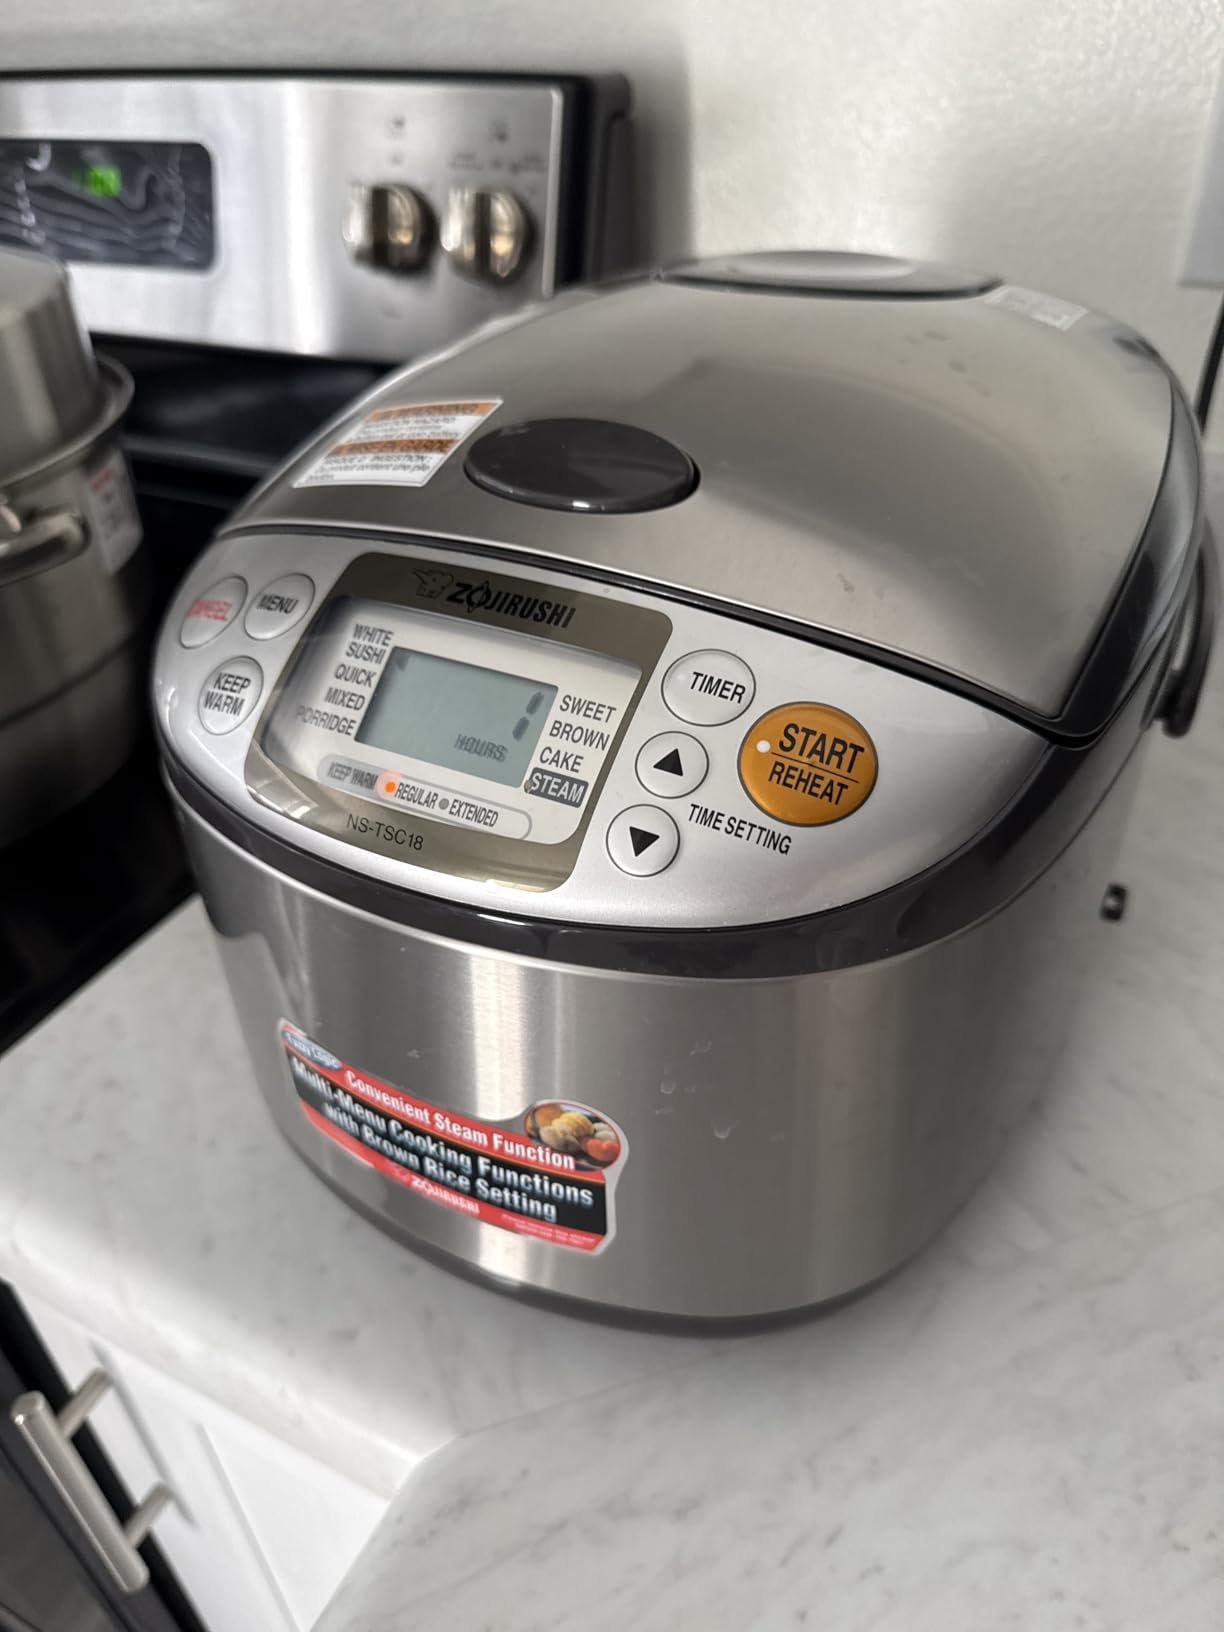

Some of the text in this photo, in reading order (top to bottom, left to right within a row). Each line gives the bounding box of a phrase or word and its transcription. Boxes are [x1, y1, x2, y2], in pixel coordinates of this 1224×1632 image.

[257, 595, 299, 614] MENU
[446, 580, 576, 629] ZOJIRUSHI
[352, 624, 394, 647] WHITE
[346, 642, 386, 665] SUSHI
[213, 673, 251, 693] KEEP
[334, 664, 376, 689] QUICK
[690, 671, 746, 704] TIMER
[204, 691, 245, 716] WARM
[324, 686, 366, 711] MIXED
[559, 694, 616, 723] SWEET
[296, 705, 357, 736] PORRIDGE
[549, 720, 610, 751] BROWN
[454, 734, 508, 762] HOURS
[539, 746, 584, 773] CAKE
[778, 723, 865, 773] START
[328, 762, 352, 782] KEEP
[768, 761, 848, 805] REHEAT
[394, 782, 439, 810] REGULAR
[530, 772, 585, 804] STEAM
[449, 798, 499, 828] EXTENDED
[347, 813, 424, 851] NS-TSC18
[688, 803, 792, 855] TIME SETTING
[344, 1069, 576, 1171] Convenient Steam Function
[322, 1101, 557, 1223] with Brown Rice Setting
[388, 1118, 472, 1175] Cooking
[477, 1153, 594, 1207] Functions
